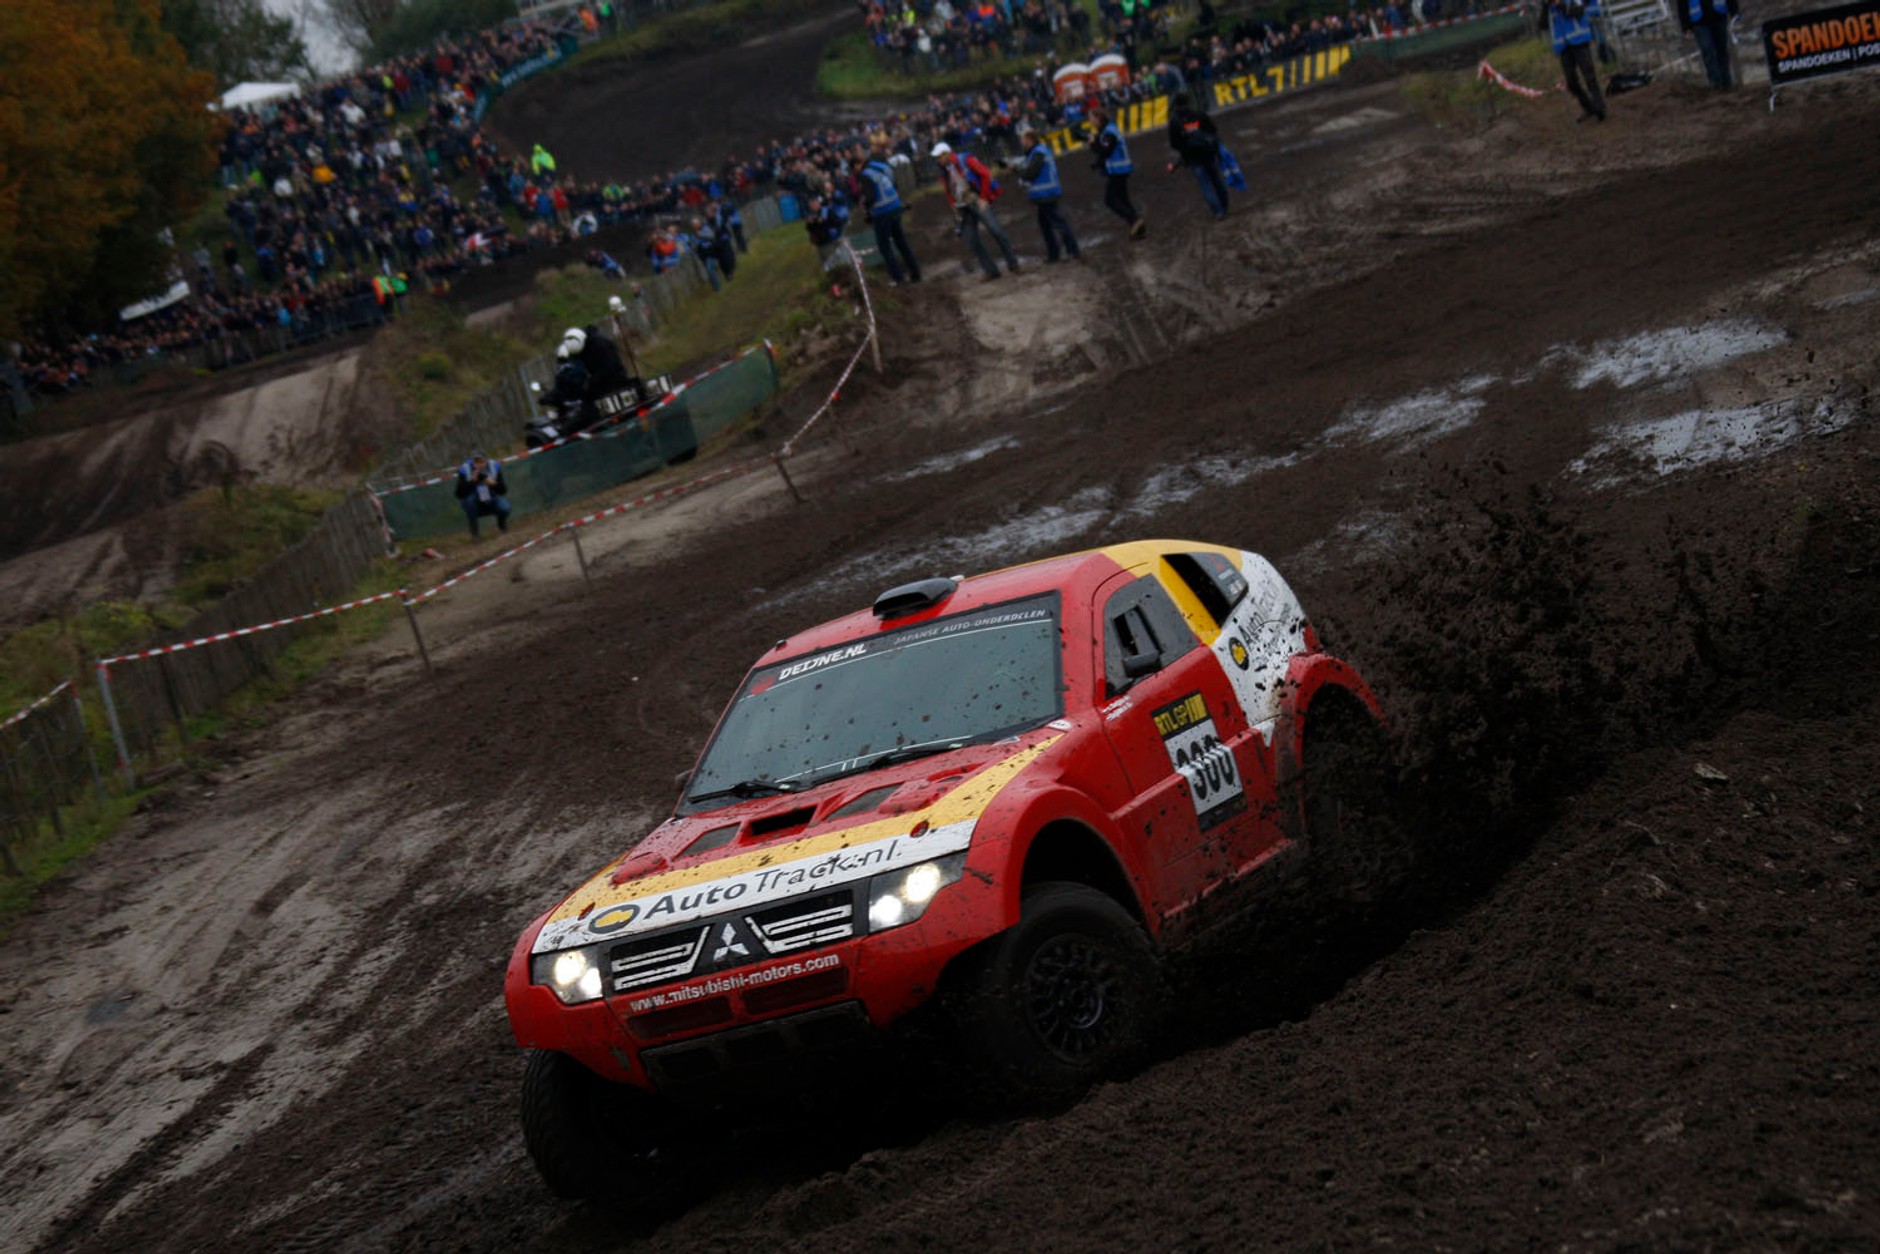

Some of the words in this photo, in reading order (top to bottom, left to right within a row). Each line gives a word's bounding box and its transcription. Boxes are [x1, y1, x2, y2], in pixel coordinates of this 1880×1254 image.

[1778, 48, 1850, 73] SPANDOEKEN
[894, 628, 938, 645] JAPANSE
[778, 643, 867, 680] DEIJNE.NL
[630, 953, 839, 1013] www.mitsubishi-motors.com
